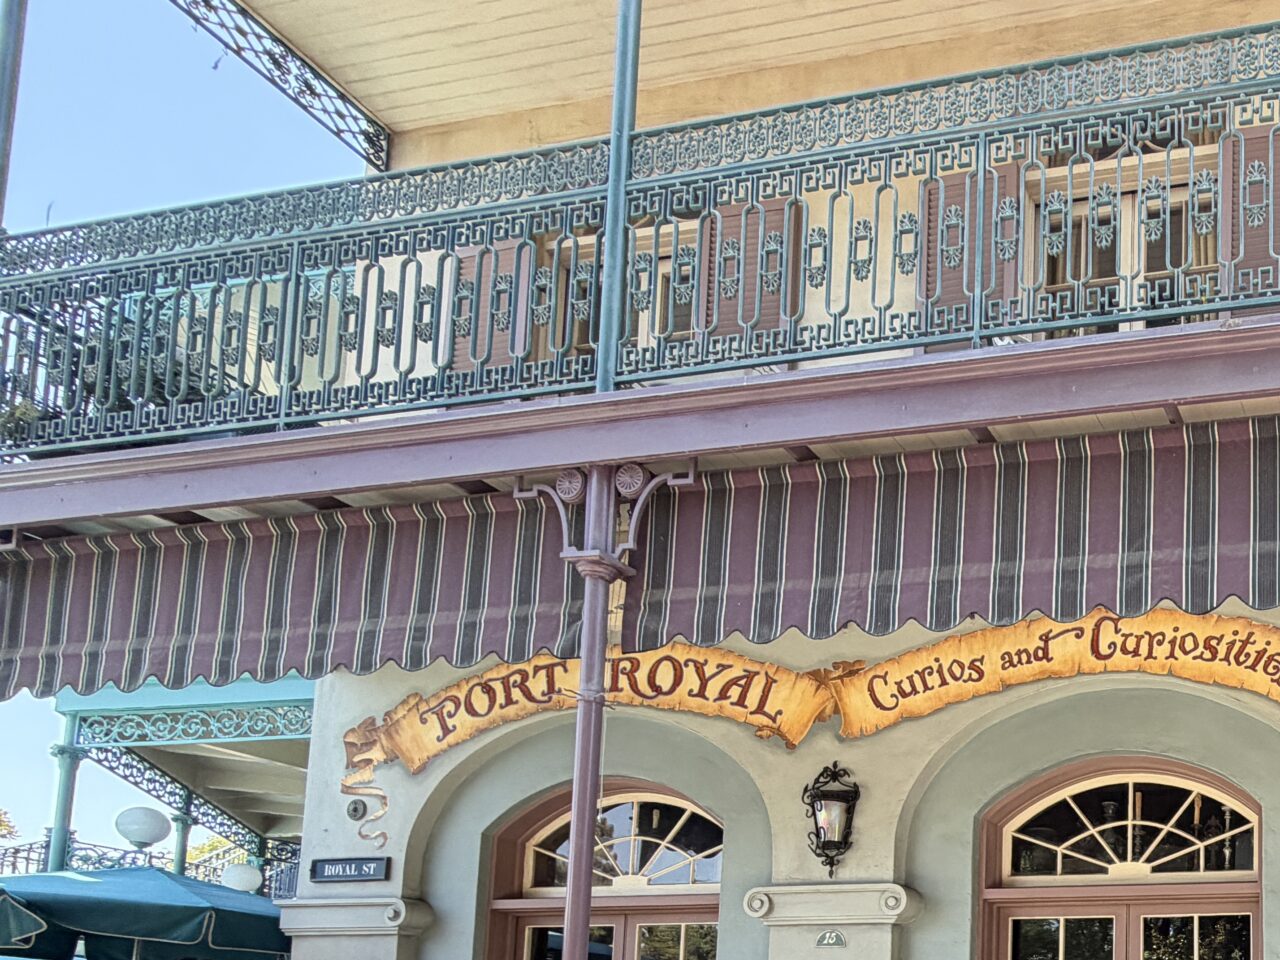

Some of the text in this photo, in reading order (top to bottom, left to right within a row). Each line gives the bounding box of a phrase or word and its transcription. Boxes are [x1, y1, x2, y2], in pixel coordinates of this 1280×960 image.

[867, 655, 985, 711] Curios
[1000, 626, 1085, 671] and
[419, 654, 783, 742] PORT ROYAL
[323, 863, 377, 876] ROYAL ST
[822, 932, 837, 944] 15
